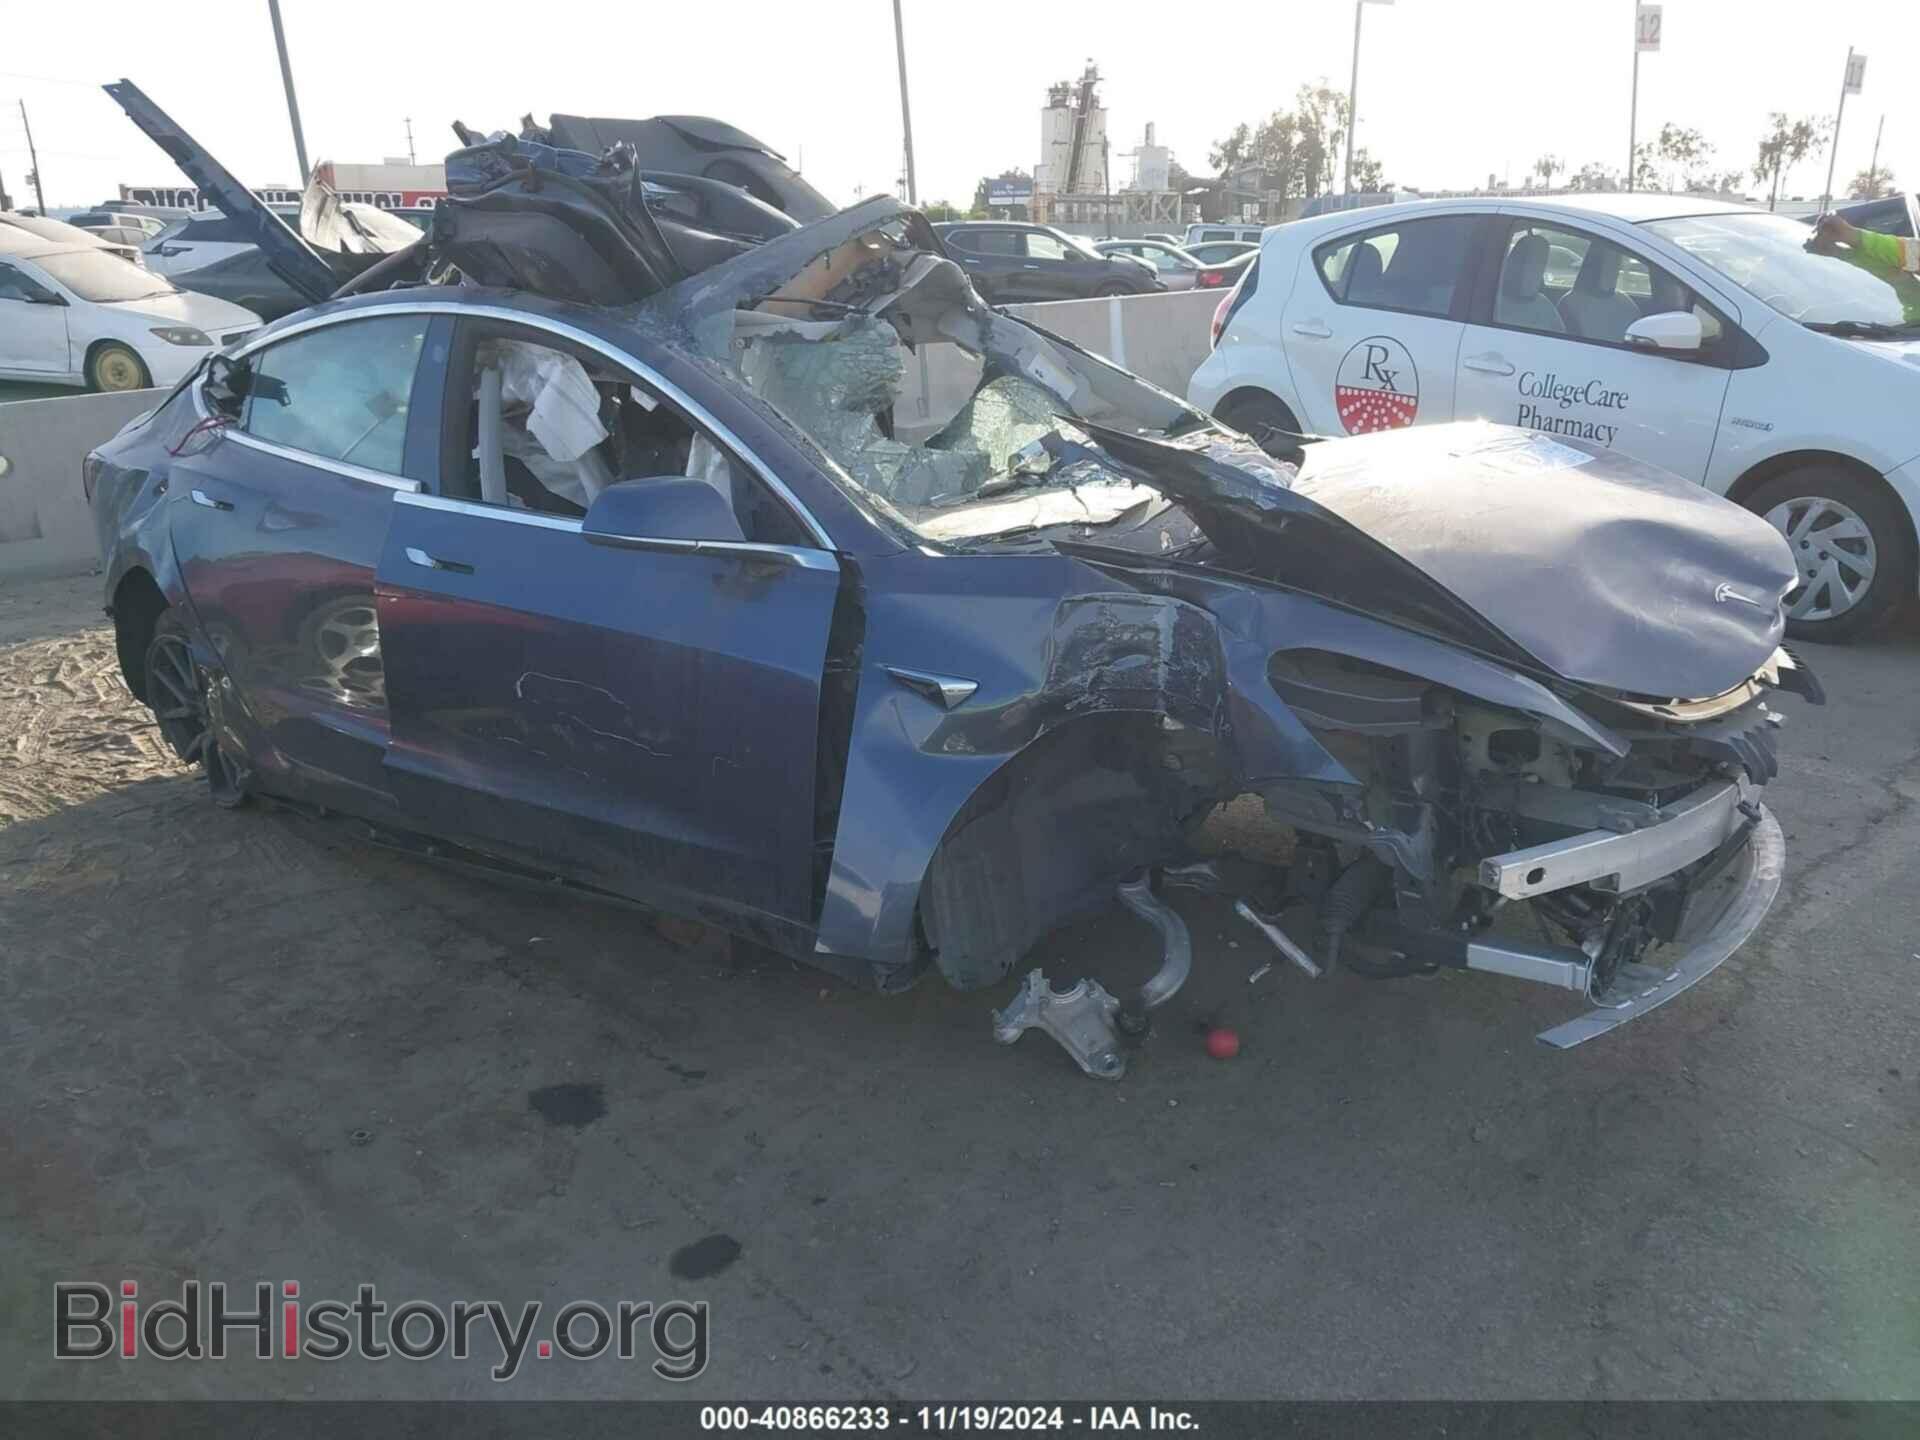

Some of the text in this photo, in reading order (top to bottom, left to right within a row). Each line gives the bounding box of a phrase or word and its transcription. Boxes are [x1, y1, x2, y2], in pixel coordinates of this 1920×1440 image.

[1638, 13, 1661, 44] 12
[1847, 61, 1864, 88] 11
[1360, 344, 1400, 392] Rx
[1518, 371, 1629, 409] CollegeCare
[1517, 404, 1619, 448] Pharmacy
